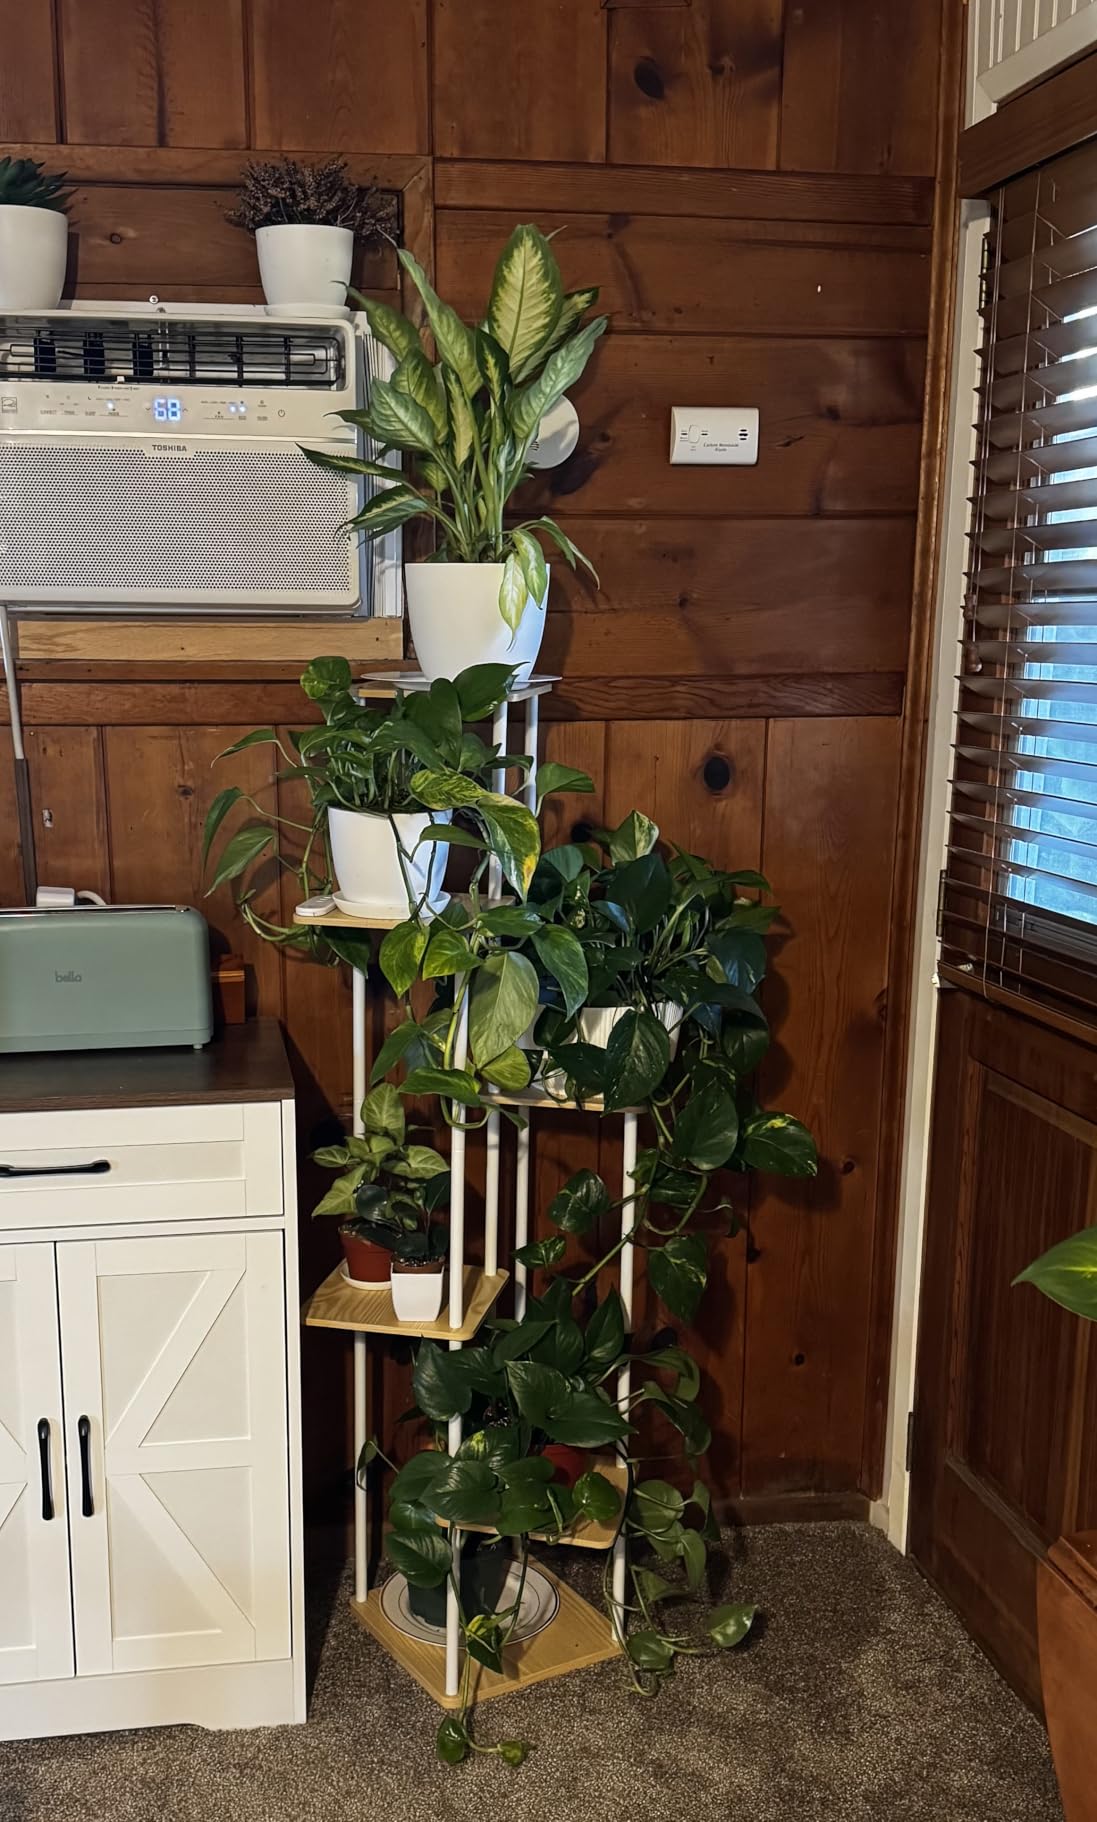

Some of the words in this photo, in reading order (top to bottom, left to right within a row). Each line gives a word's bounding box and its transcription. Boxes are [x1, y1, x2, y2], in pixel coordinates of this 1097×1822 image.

[154, 398, 181, 421] 68
[152, 444, 187, 452] TOSHIBA
[55, 970, 82, 982] bella
